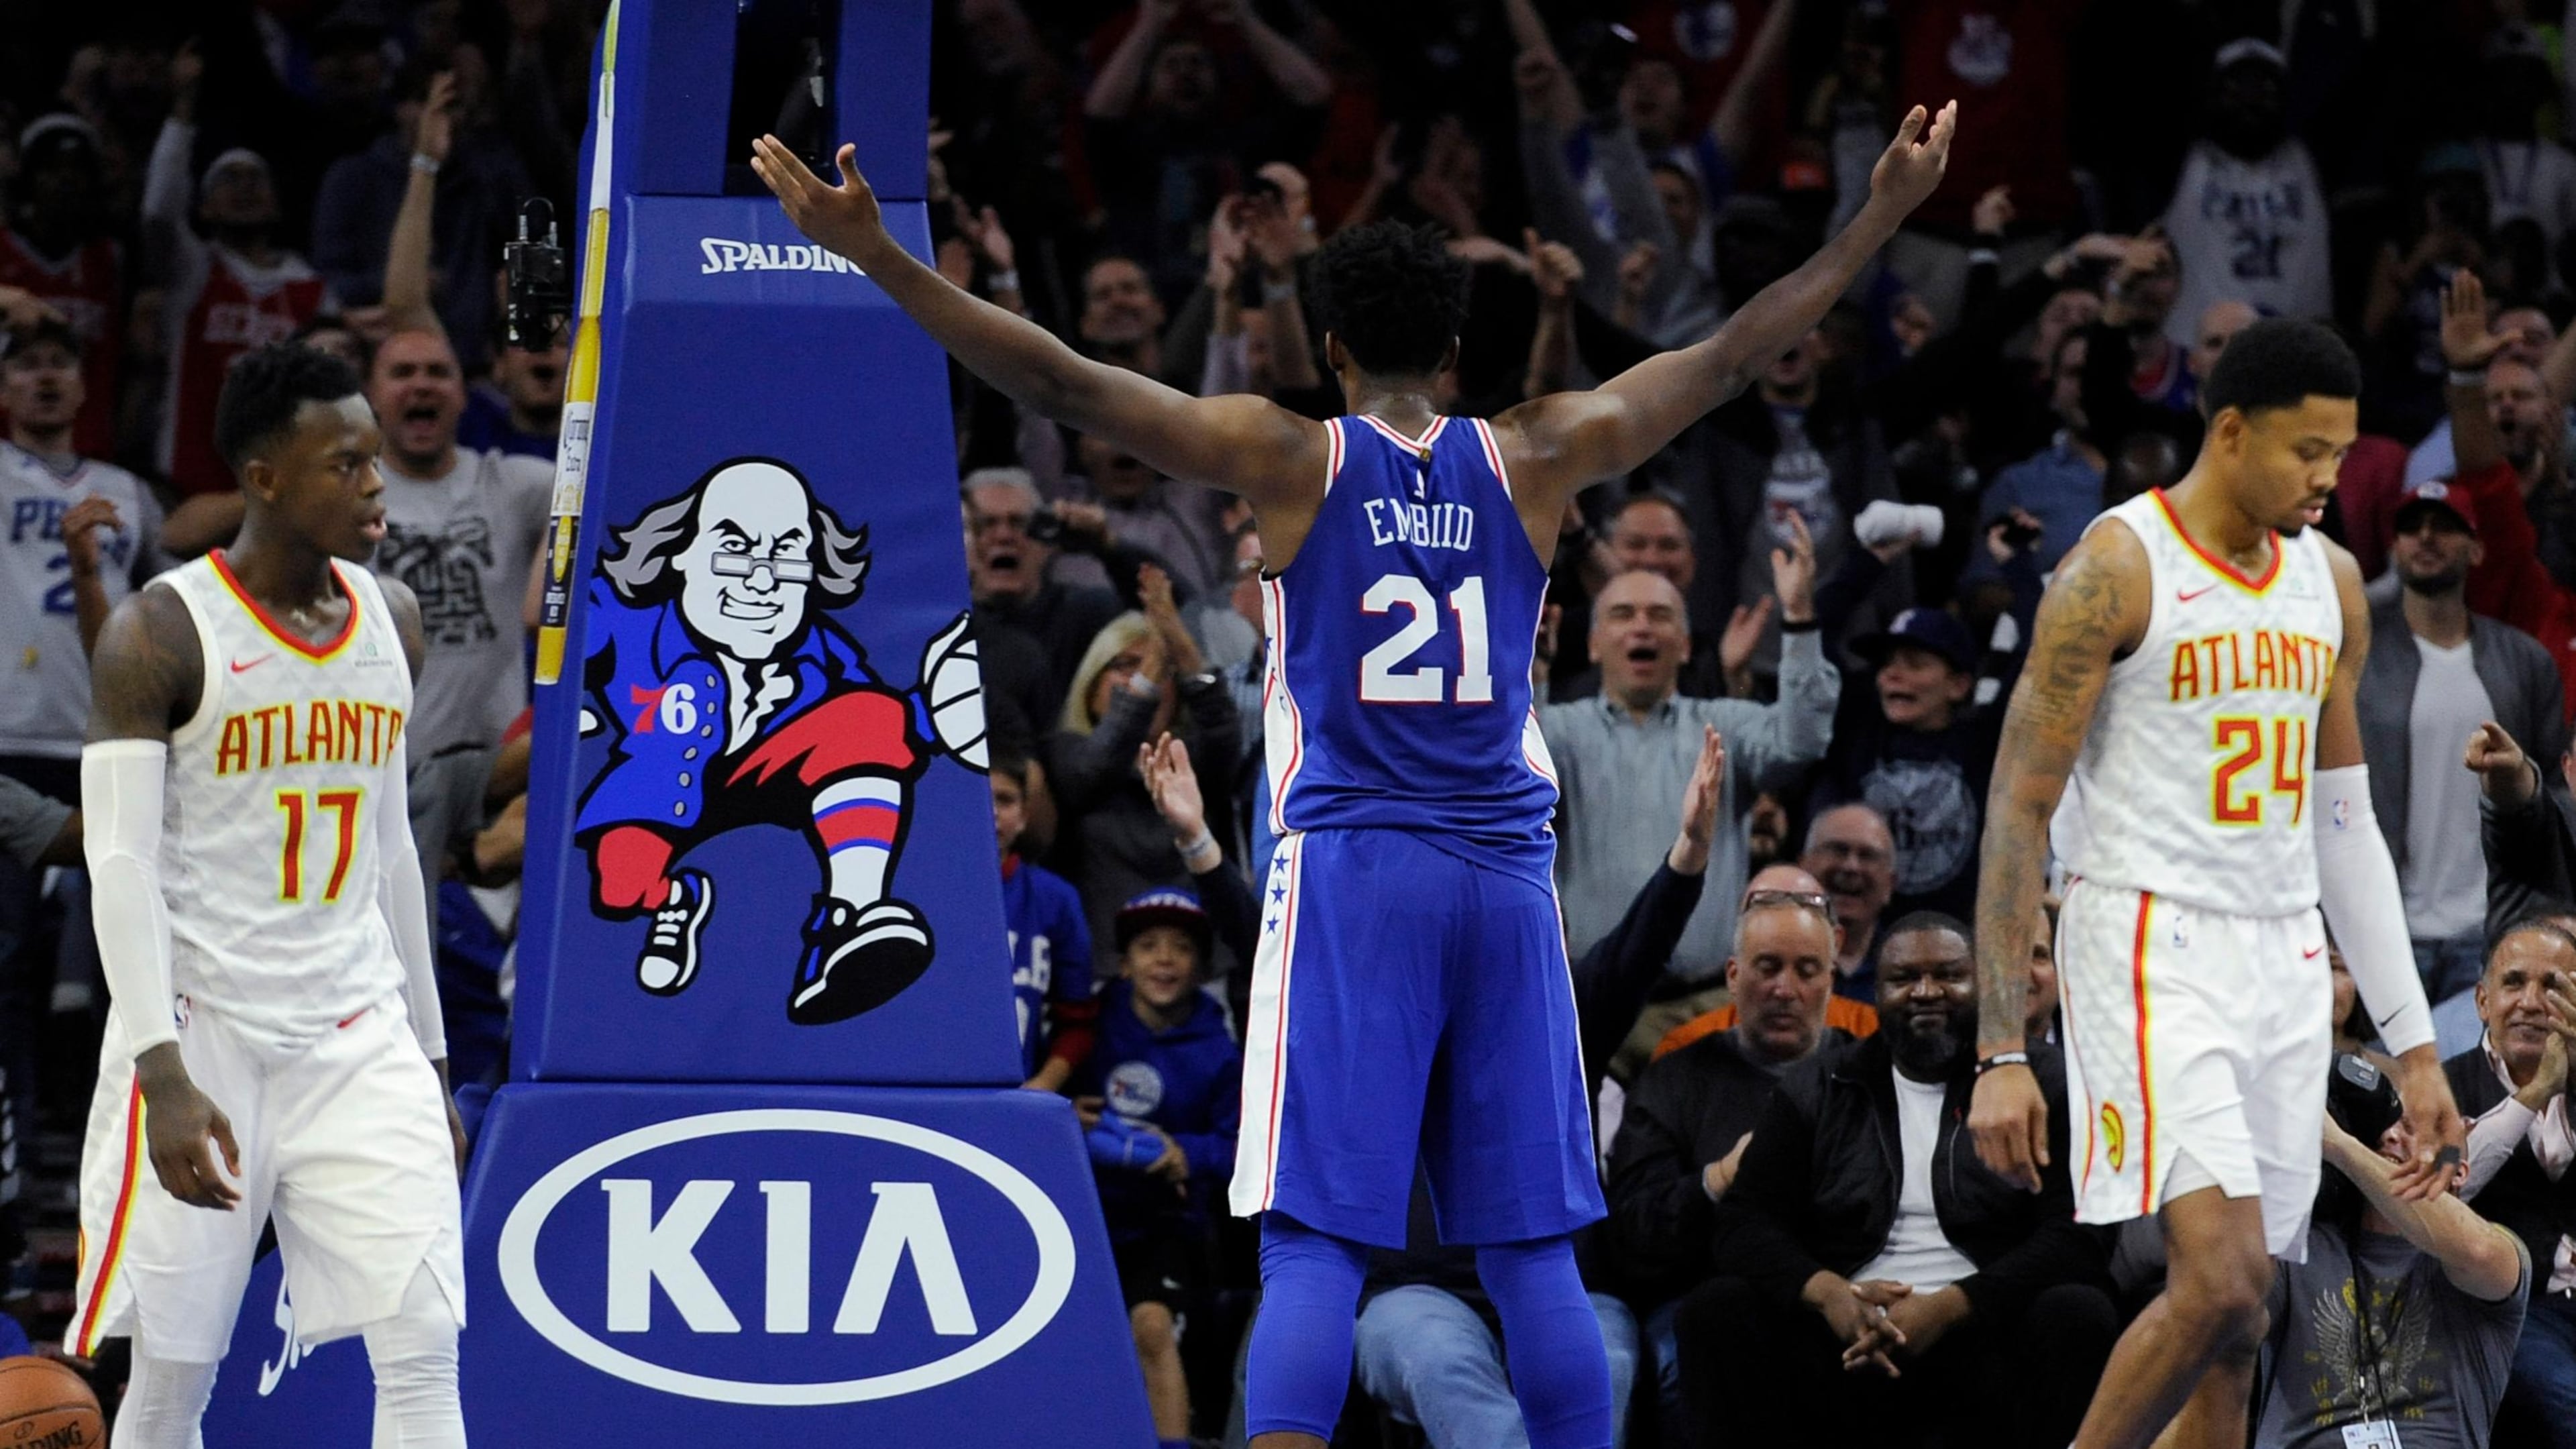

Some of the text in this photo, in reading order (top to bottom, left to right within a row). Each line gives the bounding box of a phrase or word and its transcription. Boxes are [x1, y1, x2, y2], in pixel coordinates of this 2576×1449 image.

[700, 237, 867, 276] SPALDIN
[1362, 497, 1474, 552] EMBIID
[1359, 574, 1493, 705] 21
[631, 683, 697, 735] 76
[2213, 716, 2306, 826] 24
[274, 787, 364, 903] 17
[600, 1178, 978, 1336] KIA
